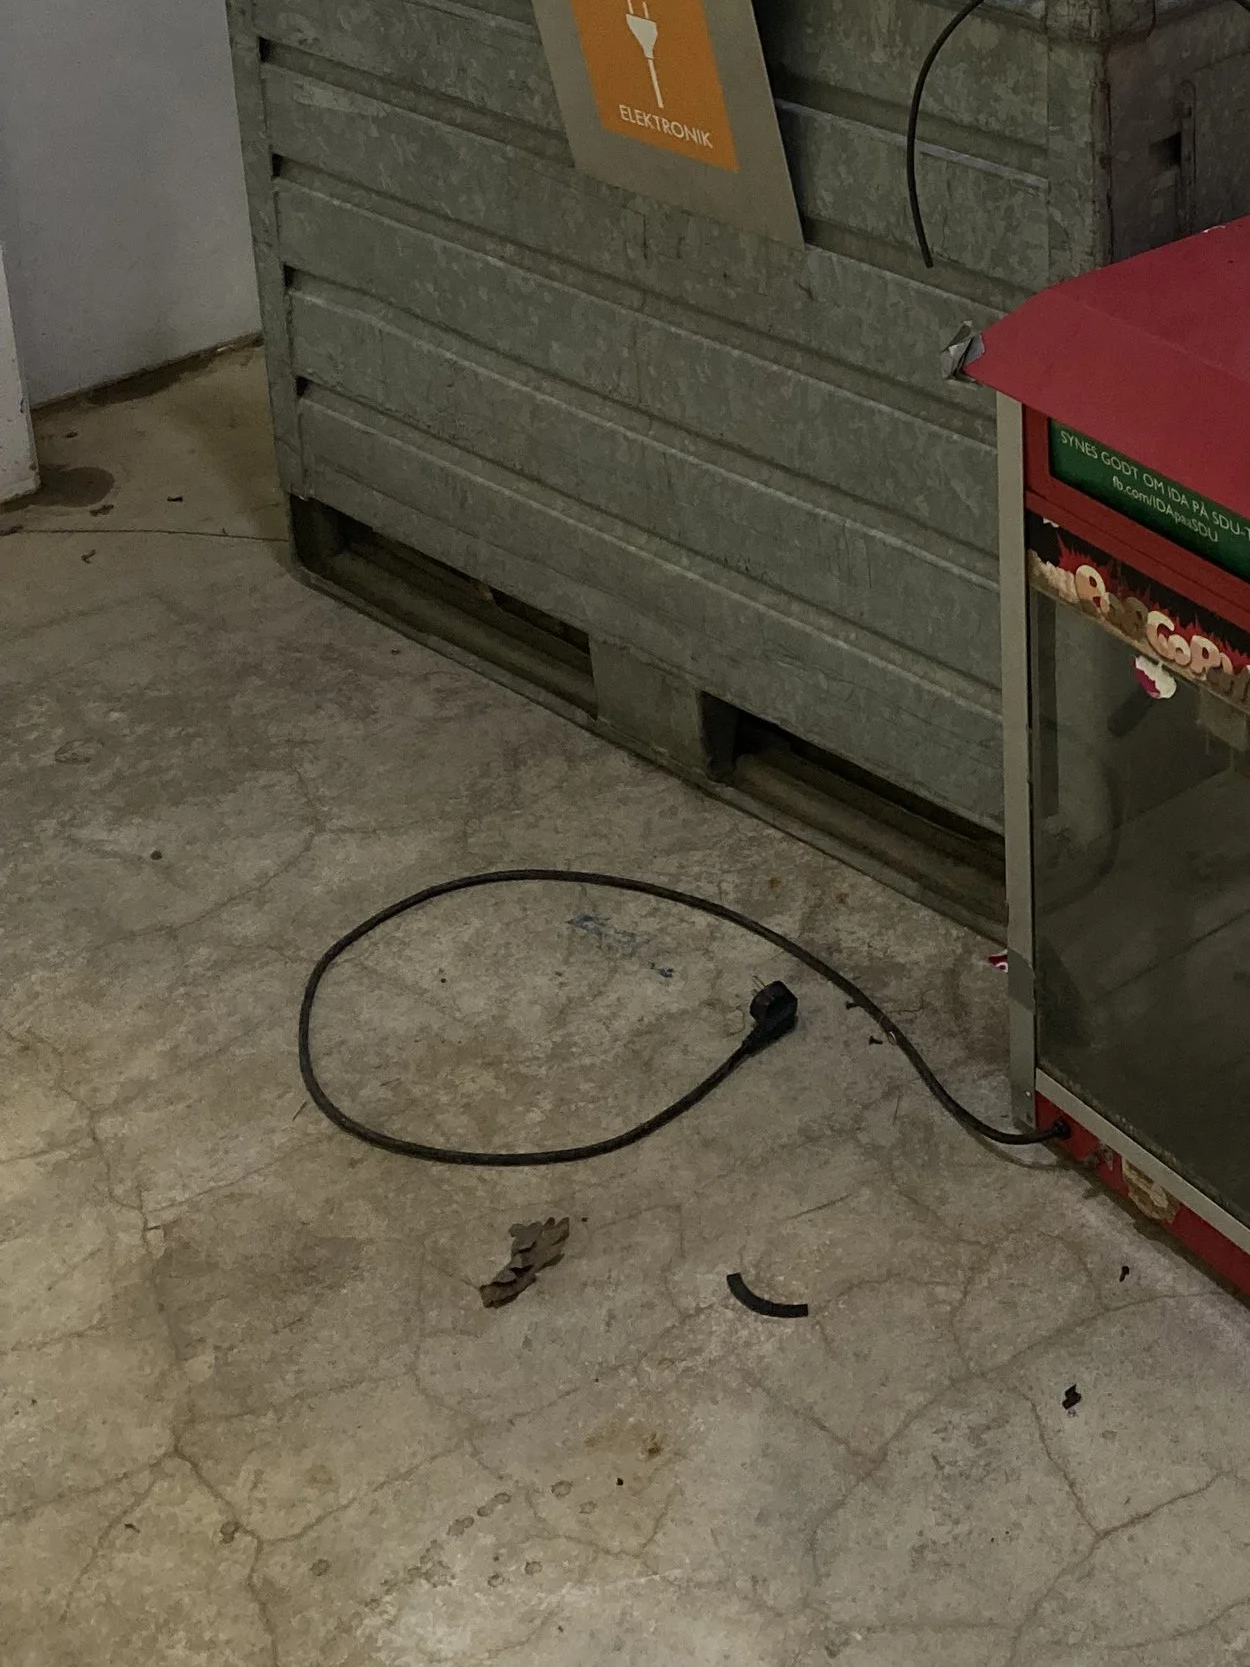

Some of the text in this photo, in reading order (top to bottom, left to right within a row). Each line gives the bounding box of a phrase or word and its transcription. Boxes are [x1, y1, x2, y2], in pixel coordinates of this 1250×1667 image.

[619, 103, 714, 149] ELEKTRONIK
[1060, 430, 1098, 459] SYNES
[1101, 451, 1138, 480] GODT
[1143, 473, 1165, 495] OM
[1167, 485, 1190, 510] IDA
[1192, 500, 1209, 521] PÅ
